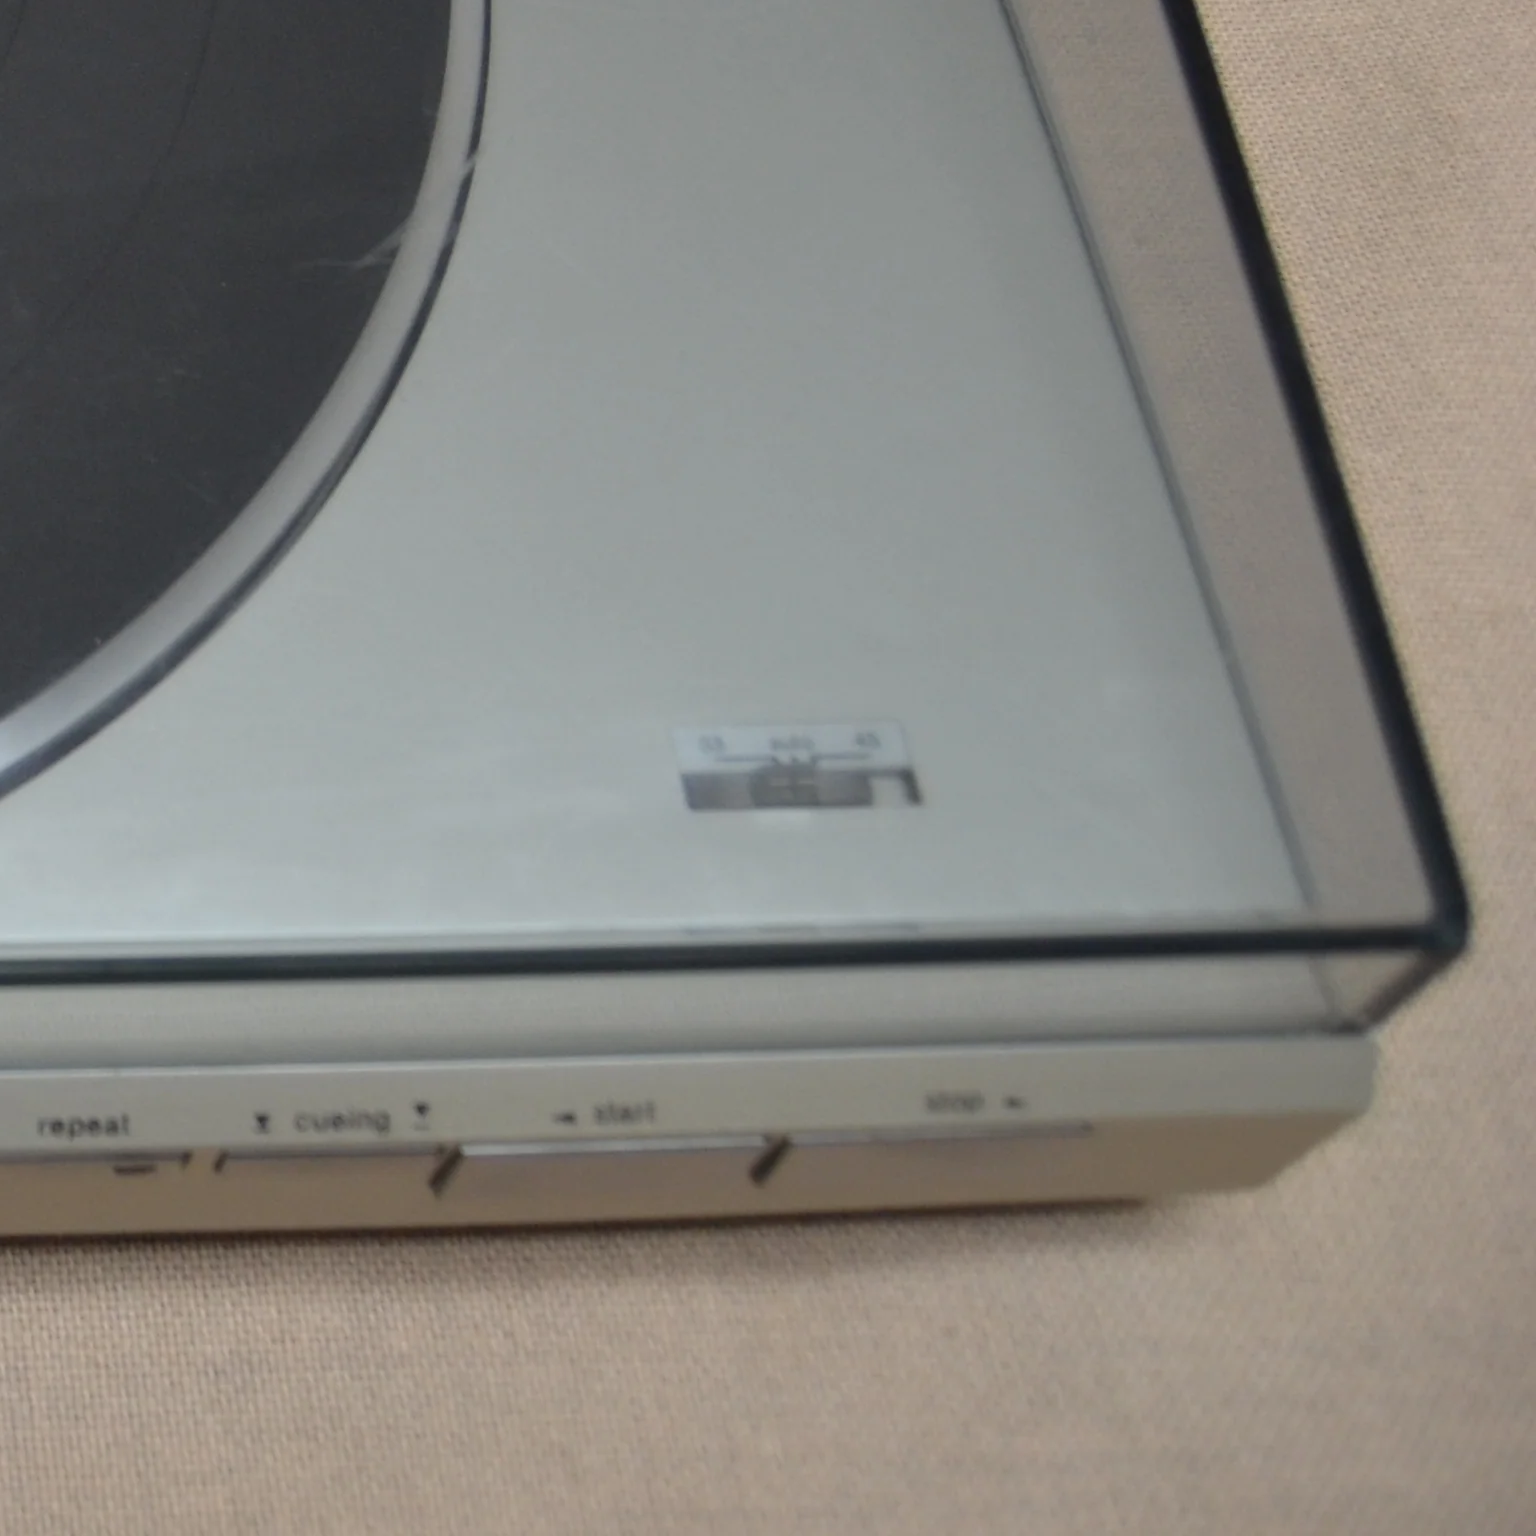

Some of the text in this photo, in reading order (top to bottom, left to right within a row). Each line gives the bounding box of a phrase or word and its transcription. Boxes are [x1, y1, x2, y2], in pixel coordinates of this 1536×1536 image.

[37, 1112, 133, 1140] repeat
[293, 1107, 392, 1135] cueing
[592, 1100, 657, 1127] start
